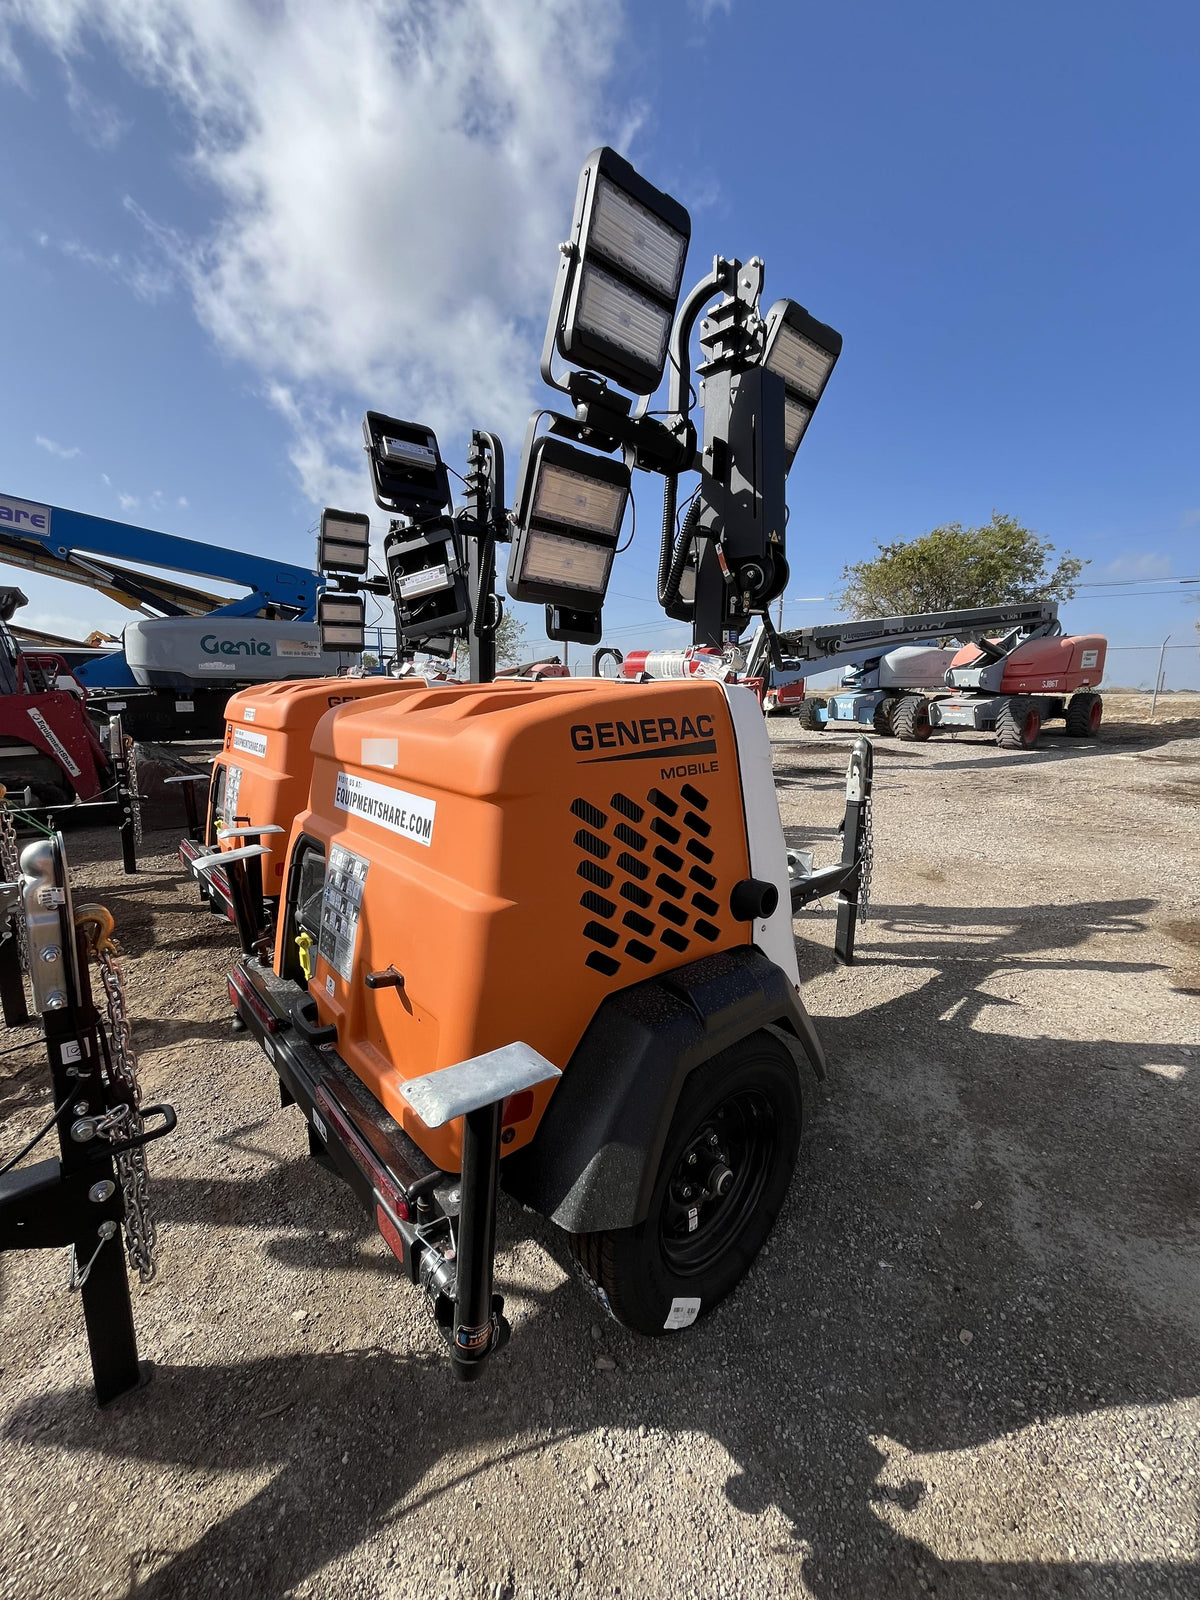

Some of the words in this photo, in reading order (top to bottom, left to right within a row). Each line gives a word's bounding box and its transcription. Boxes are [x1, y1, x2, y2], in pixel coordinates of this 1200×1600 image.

[200, 634, 272, 656] Genie
[570, 714, 714, 752] GENERAC
[660, 760, 719, 780] MOBILE
[336, 786, 432, 839] EQUIPMENTSHARE.COM
